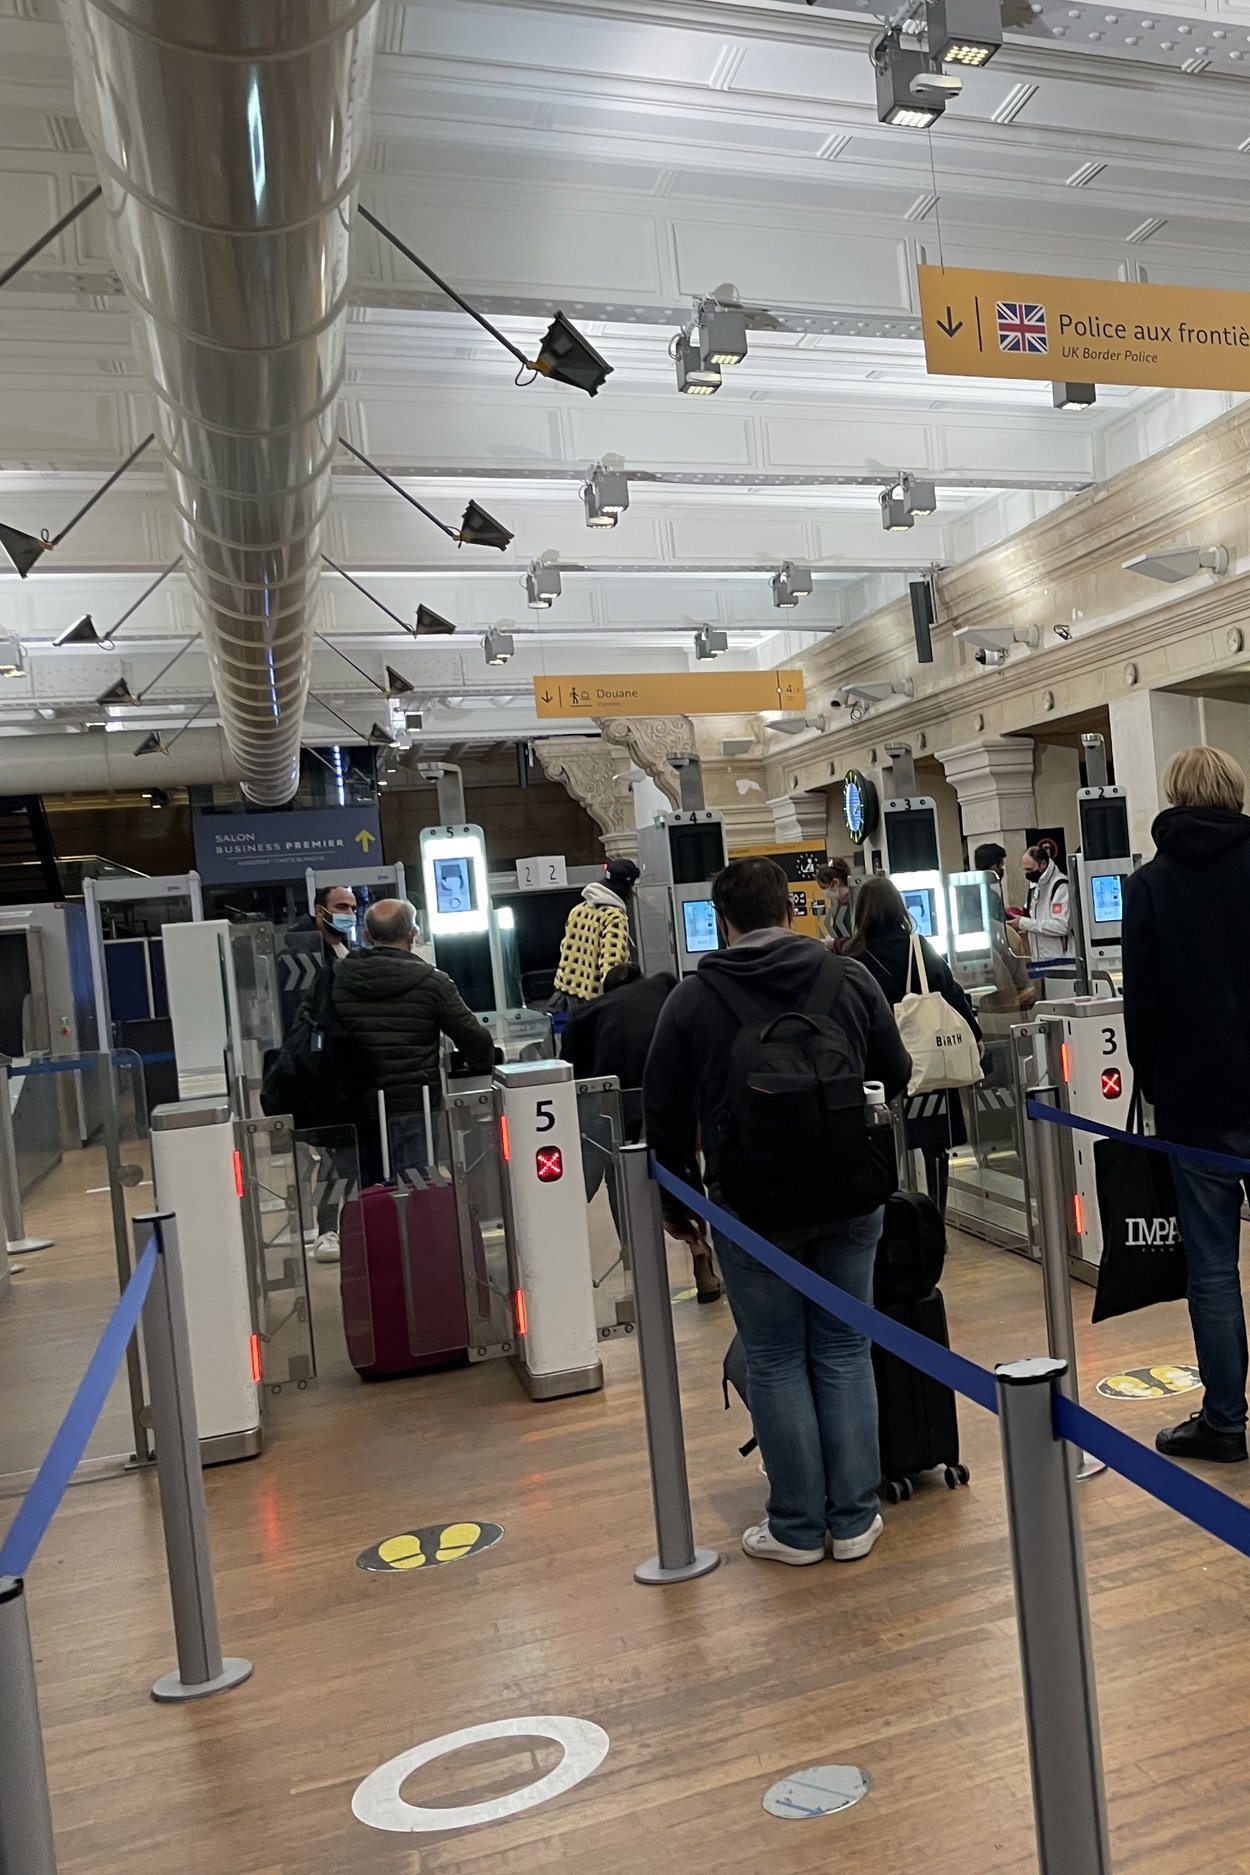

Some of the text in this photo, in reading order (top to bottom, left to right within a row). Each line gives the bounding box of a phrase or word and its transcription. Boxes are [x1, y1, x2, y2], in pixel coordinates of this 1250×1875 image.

[1059, 314, 1127, 339] Police
[1134, 325, 1172, 342] aux
[1062, 346, 1158, 363] UK Border Police
[596, 689, 638, 699] Douane
[1098, 787, 1105, 799] 2
[904, 799, 912, 811] 3
[689, 811, 698, 825] 4
[215, 833, 255, 843] SALON
[446, 826, 454, 838] 5
[215, 839, 345, 854] BUSINESS PREMIER
[525, 865, 557, 883] 2 2
[1101, 1028, 1118, 1055] 3
[536, 1100, 556, 1132] 5
